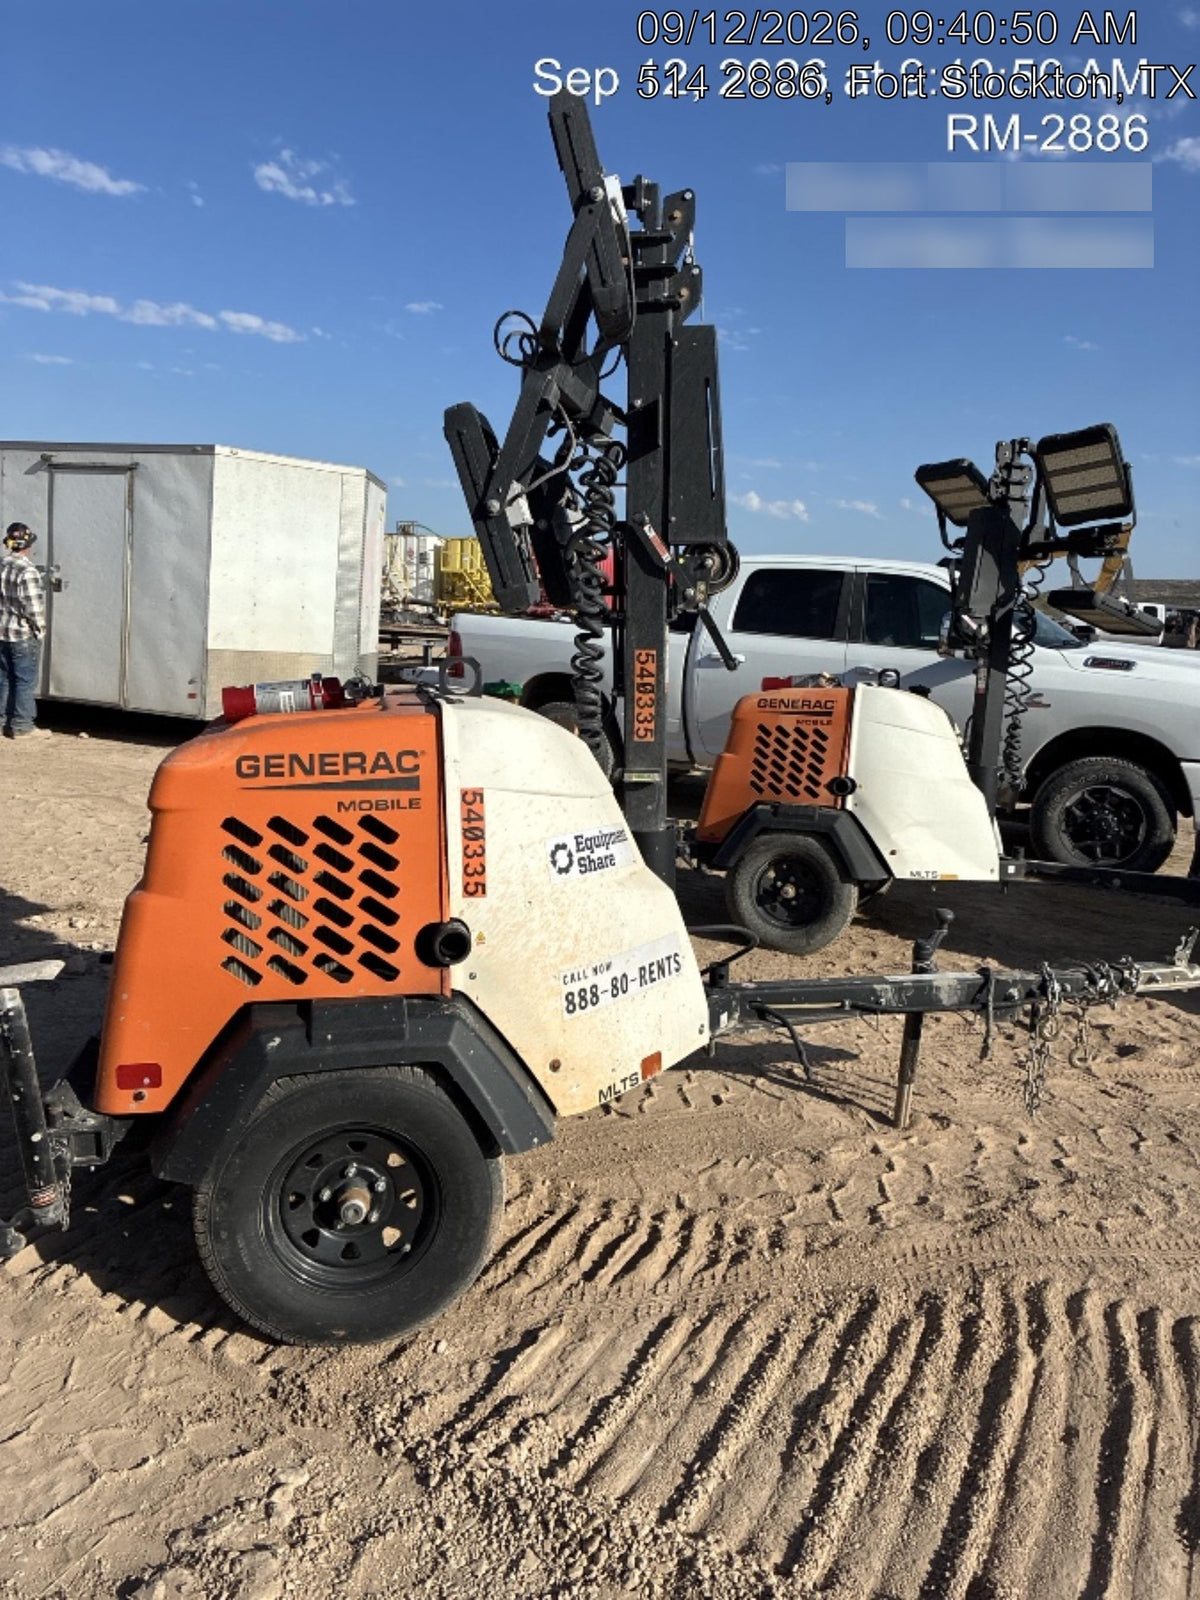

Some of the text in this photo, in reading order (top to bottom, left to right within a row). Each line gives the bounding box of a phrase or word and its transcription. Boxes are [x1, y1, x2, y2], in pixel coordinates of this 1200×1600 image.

[633, 651, 655, 739] 540335
[757, 698, 835, 710] GENERAC
[235, 750, 421, 780] GENERAC
[336, 798, 422, 812] MOBILE
[461, 790, 486, 896] 540335
[577, 853, 616, 874] Share
[563, 961, 612, 985] CALL NOW
[565, 953, 681, 1014] 888-80-RENTS
[598, 1072, 640, 1103] MLTS
